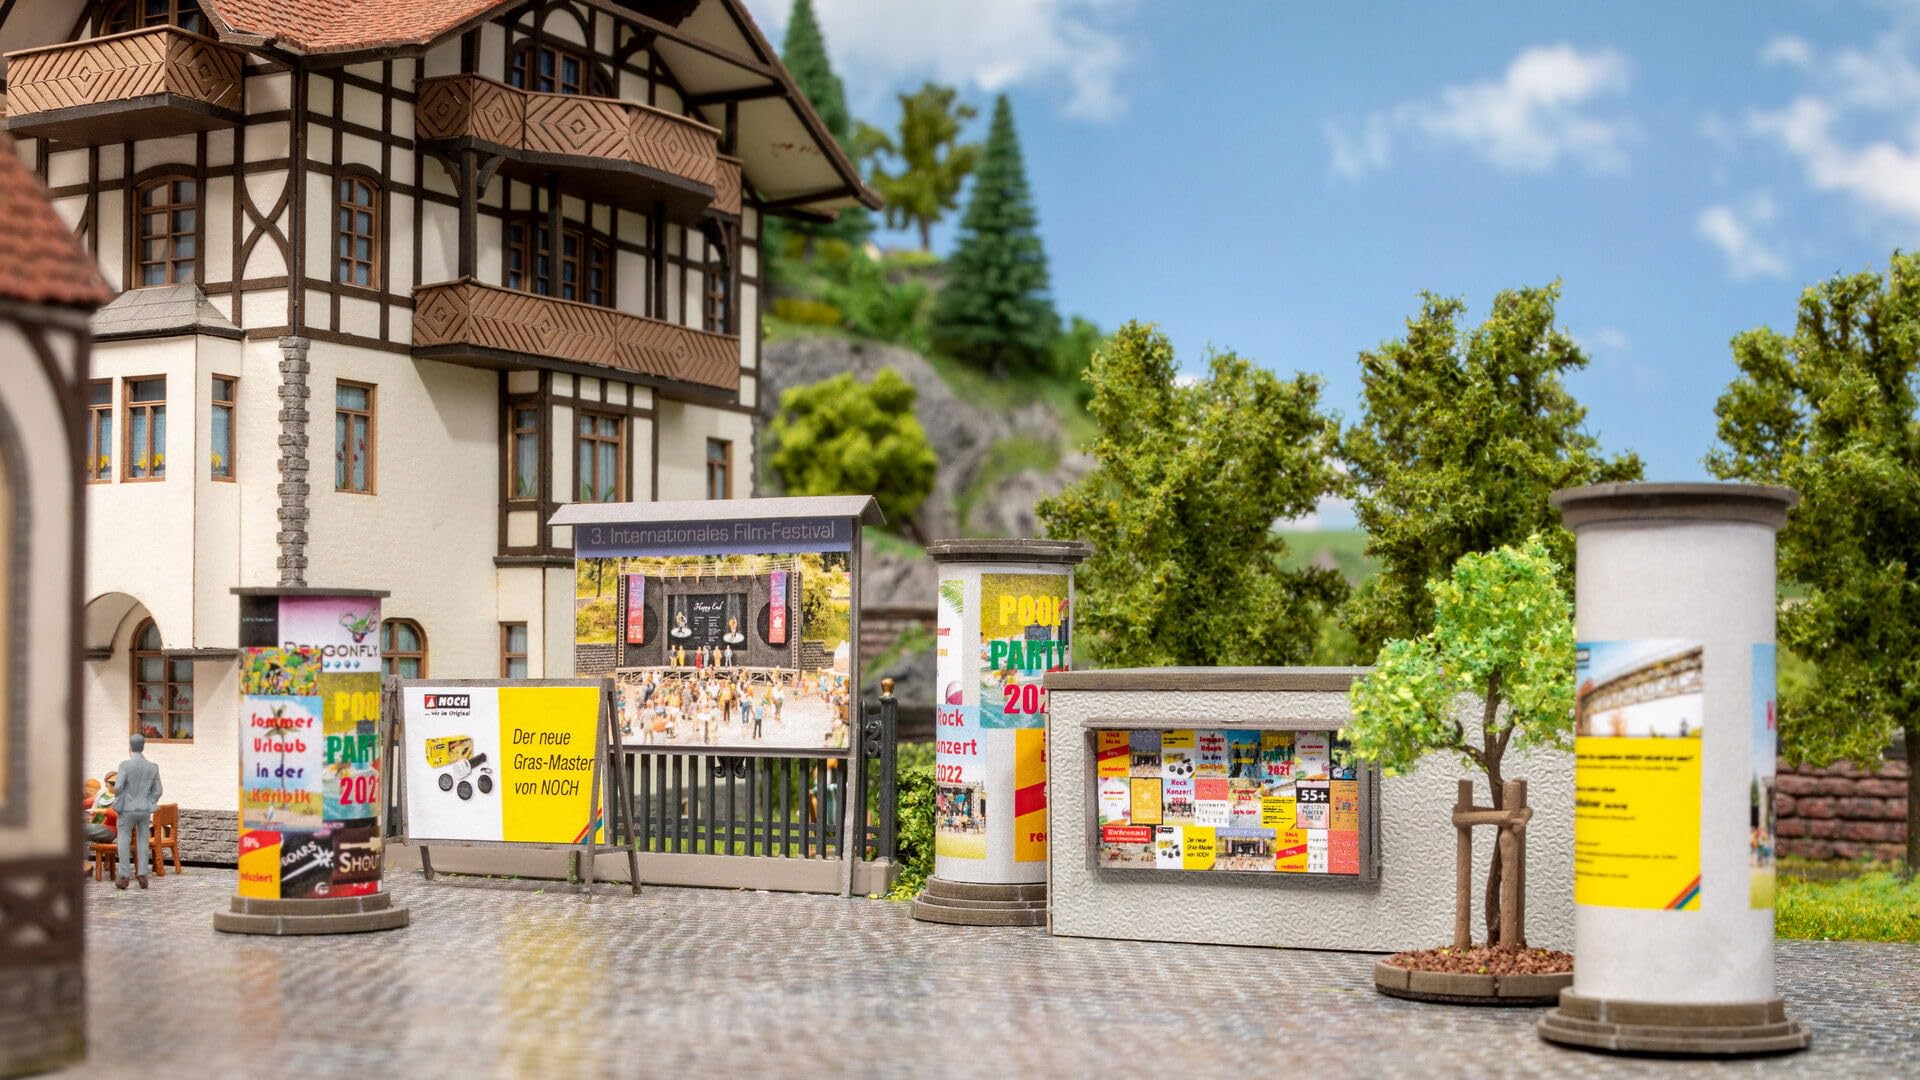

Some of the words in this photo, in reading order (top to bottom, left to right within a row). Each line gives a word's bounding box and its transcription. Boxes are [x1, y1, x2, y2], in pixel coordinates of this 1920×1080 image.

[591, 528, 605, 545] 3.
[610, 524, 729, 544] Internationales
[734, 521, 835, 540] Film-Festival
[693, 602, 711, 612] Happy
[712, 600, 724, 611] End
[999, 594, 1062, 627] POOL
[284, 641, 378, 658] DGONFLY
[990, 639, 1067, 671] PARTY
[438, 696, 469, 707] NOCH
[251, 713, 313, 728] Sommer
[938, 707, 964, 727] Rock
[513, 728, 536, 745] Der
[539, 732, 571, 745] neue
[254, 738, 306, 753] Urlaub
[256, 763, 269, 778] in
[274, 763, 304, 778] der
[513, 753, 595, 771] Gras-Master
[515, 782, 537, 795] von
[541, 779, 580, 796] NOCH
[1301, 789, 1328, 801] 55+
[252, 789, 311, 804] Karibik
